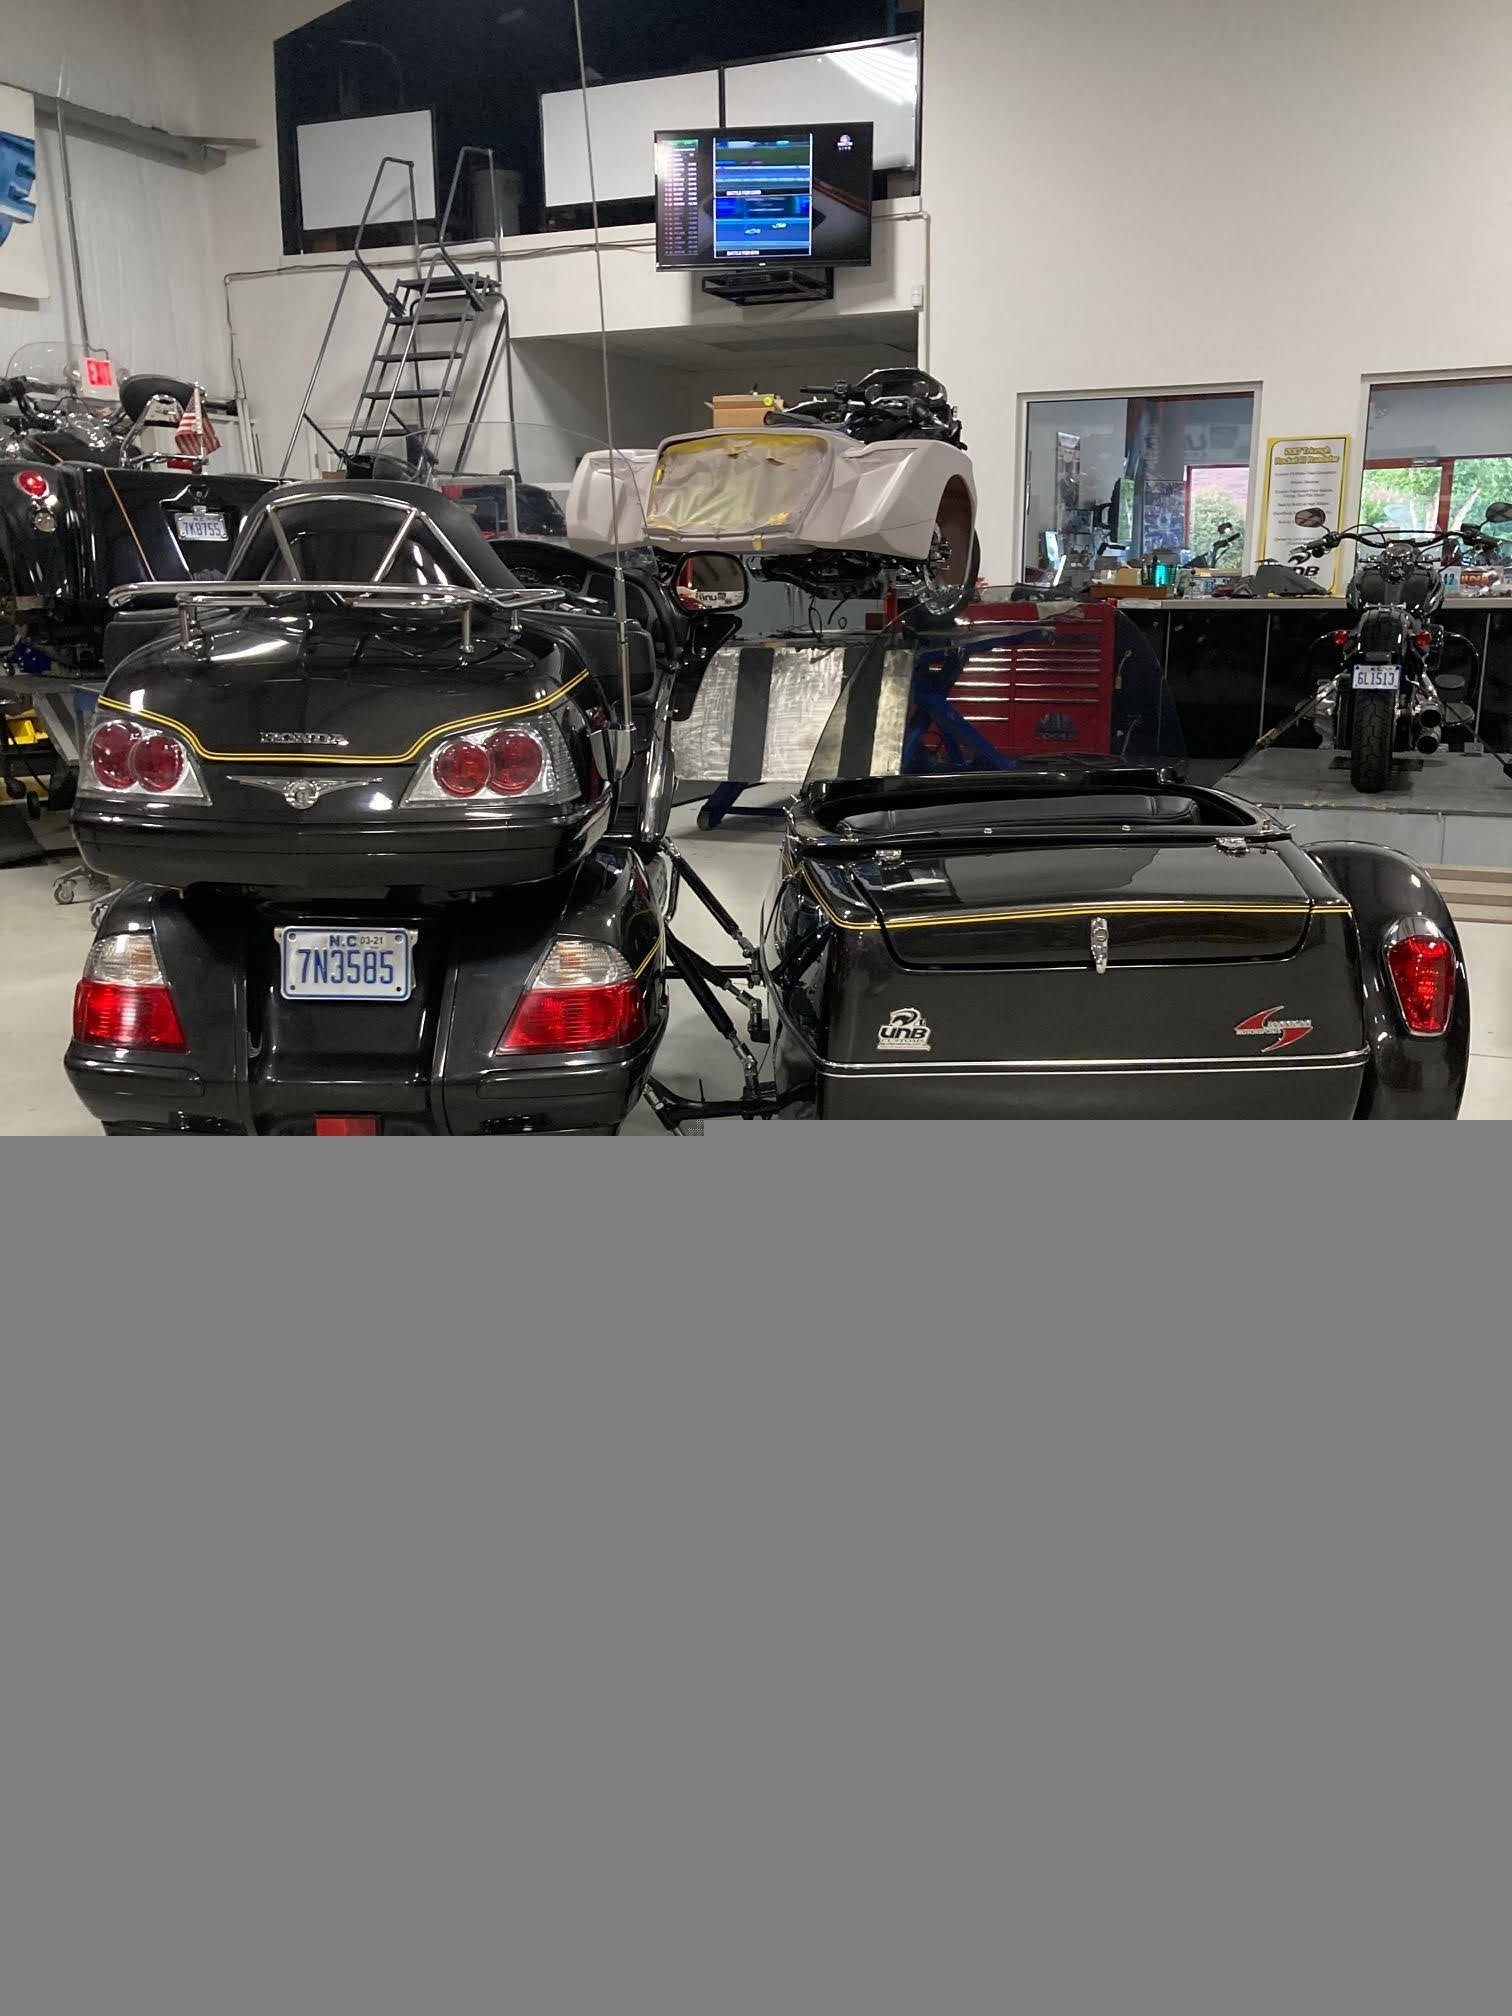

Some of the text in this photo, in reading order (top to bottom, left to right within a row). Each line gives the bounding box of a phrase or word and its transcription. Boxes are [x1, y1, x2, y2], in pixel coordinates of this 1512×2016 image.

[260, 732, 349, 746] HONDA
[360, 936, 384, 945] 03-21
[297, 948, 394, 985] 7N3585
